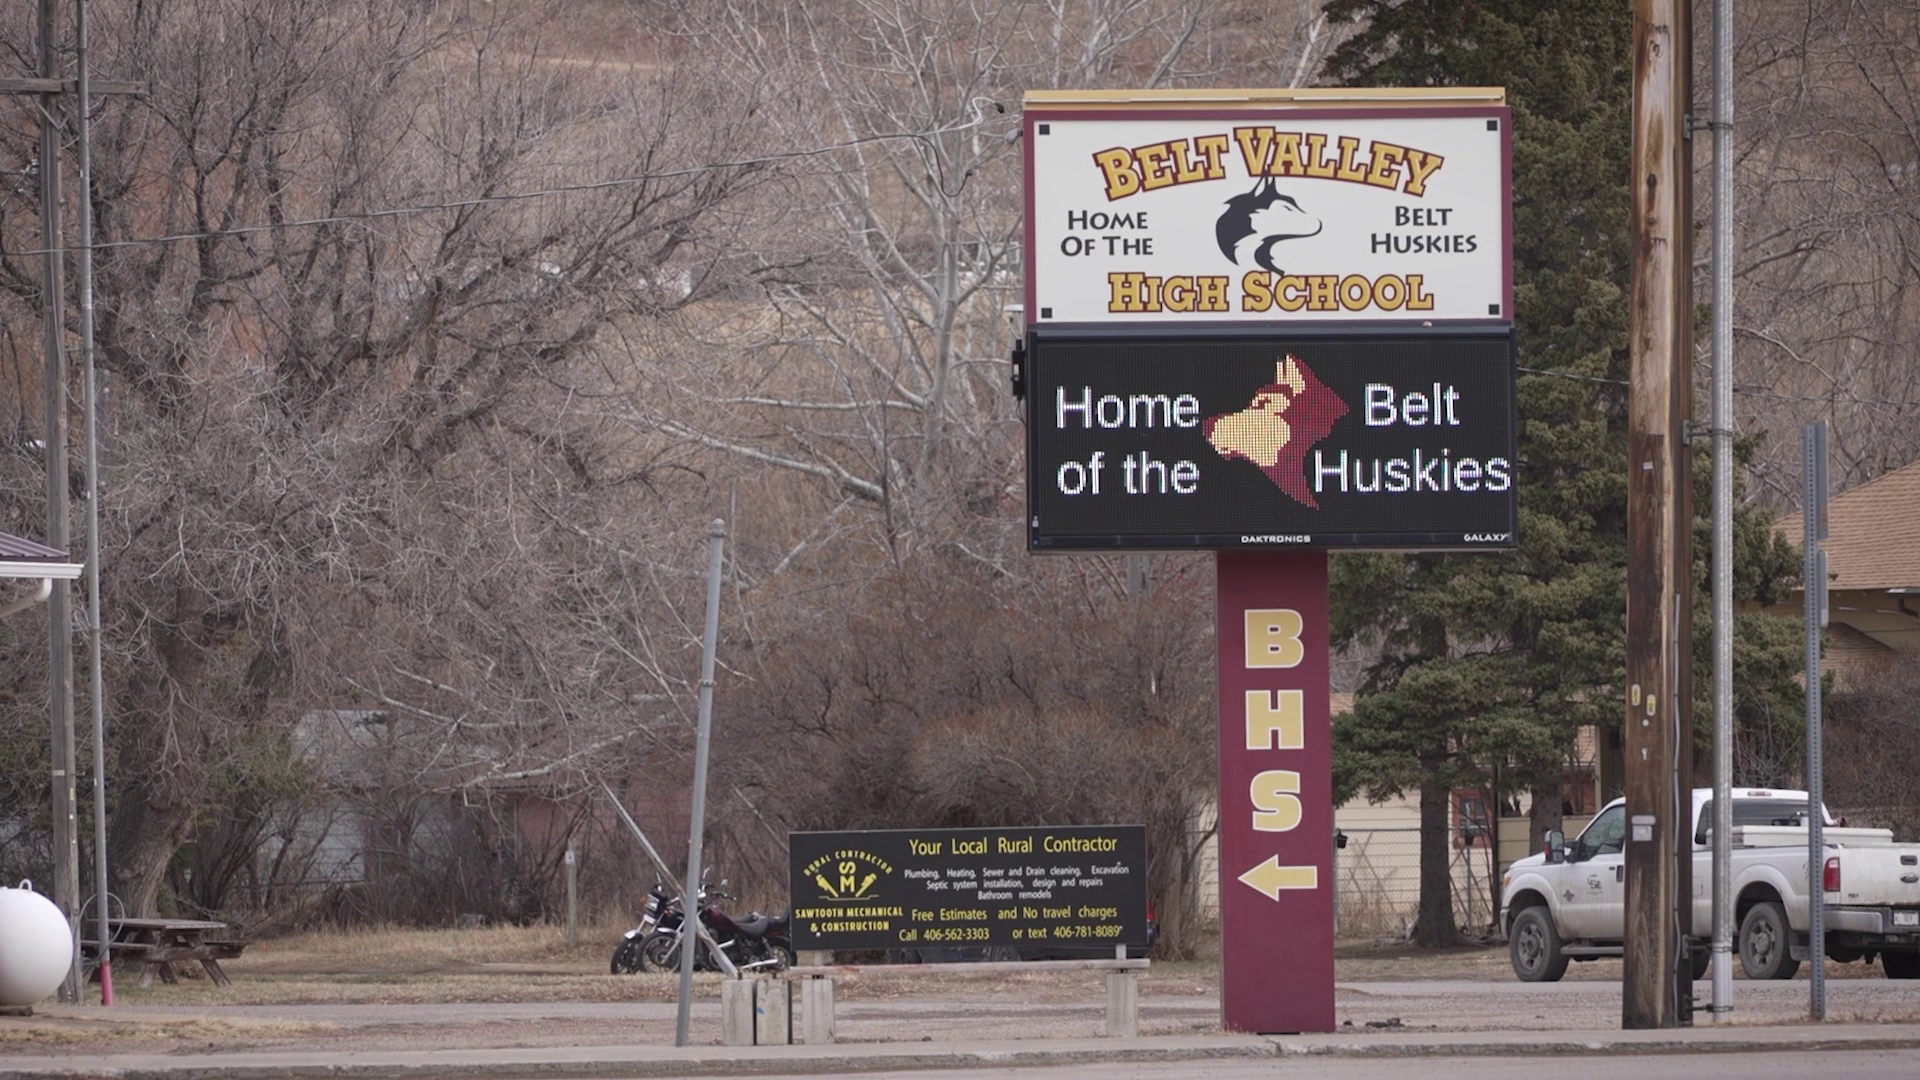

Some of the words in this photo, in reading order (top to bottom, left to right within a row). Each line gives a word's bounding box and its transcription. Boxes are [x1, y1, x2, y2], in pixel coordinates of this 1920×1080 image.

[1092, 134, 1229, 201] BELT
[1233, 126, 1445, 197] VALLEY
[1067, 210, 1148, 230] HOME
[1394, 206, 1453, 226] BELT
[1060, 236, 1097, 256] OF
[1102, 236, 1154, 256] THE
[1370, 232, 1477, 254] HUSKIES
[1108, 271, 1230, 313] HIGH
[1241, 270, 1434, 312] SCHOOL
[1056, 385, 1200, 429] Home
[1364, 382, 1460, 427] Belt
[1057, 451, 1105, 495] of
[1123, 451, 1200, 494] the
[1314, 447, 1512, 493] Huskies
[1241, 535, 1311, 543] DAKTRONICS
[1464, 533, 1507, 542] GALAXY
[909, 839, 942, 855] Your
[951, 836, 988, 854] Local
[997, 836, 1033, 853] Rural
[1043, 835, 1118, 852] Contractor
[835, 850, 893, 874] CONTRACTOR
[904, 868, 940, 880] Plumbing,
[946, 867, 976, 879] Heating,
[982, 867, 1005, 877] Sewer
[1008, 866, 1022, 877] and
[1026, 866, 1045, 876] Drain
[1050, 865, 1082, 877] cleaning,
[1091, 865, 1129, 875] Excavation
[926, 880, 948, 891] Septic
[953, 880, 977, 891] system
[983, 878, 1024, 889] installation,
[1032, 878, 1056, 889] design
[1061, 877, 1075, 887] and
[1079, 877, 1103, 888] repairs
[977, 890, 1013, 900] Bathroom
[1018, 889, 1052, 899] remodels
[795, 908, 844, 918] SAWTOOTH
[846, 906, 903, 917] MECHANICAL
[911, 909, 934, 921] Free
[940, 908, 988, 921] Estimates
[997, 906, 1018, 919] and
[1023, 906, 1038, 919] No
[1042, 905, 1071, 918] travel
[1078, 905, 1118, 921] charges
[810, 922, 818, 932] &
[821, 921, 890, 932] CONSTRUCTION
[899, 928, 917, 941] Call
[923, 927, 990, 940] 406-562-3303
[1012, 929, 1023, 939] or
[1028, 927, 1047, 939] text
[1053, 925, 1120, 938] 406-781-8089
